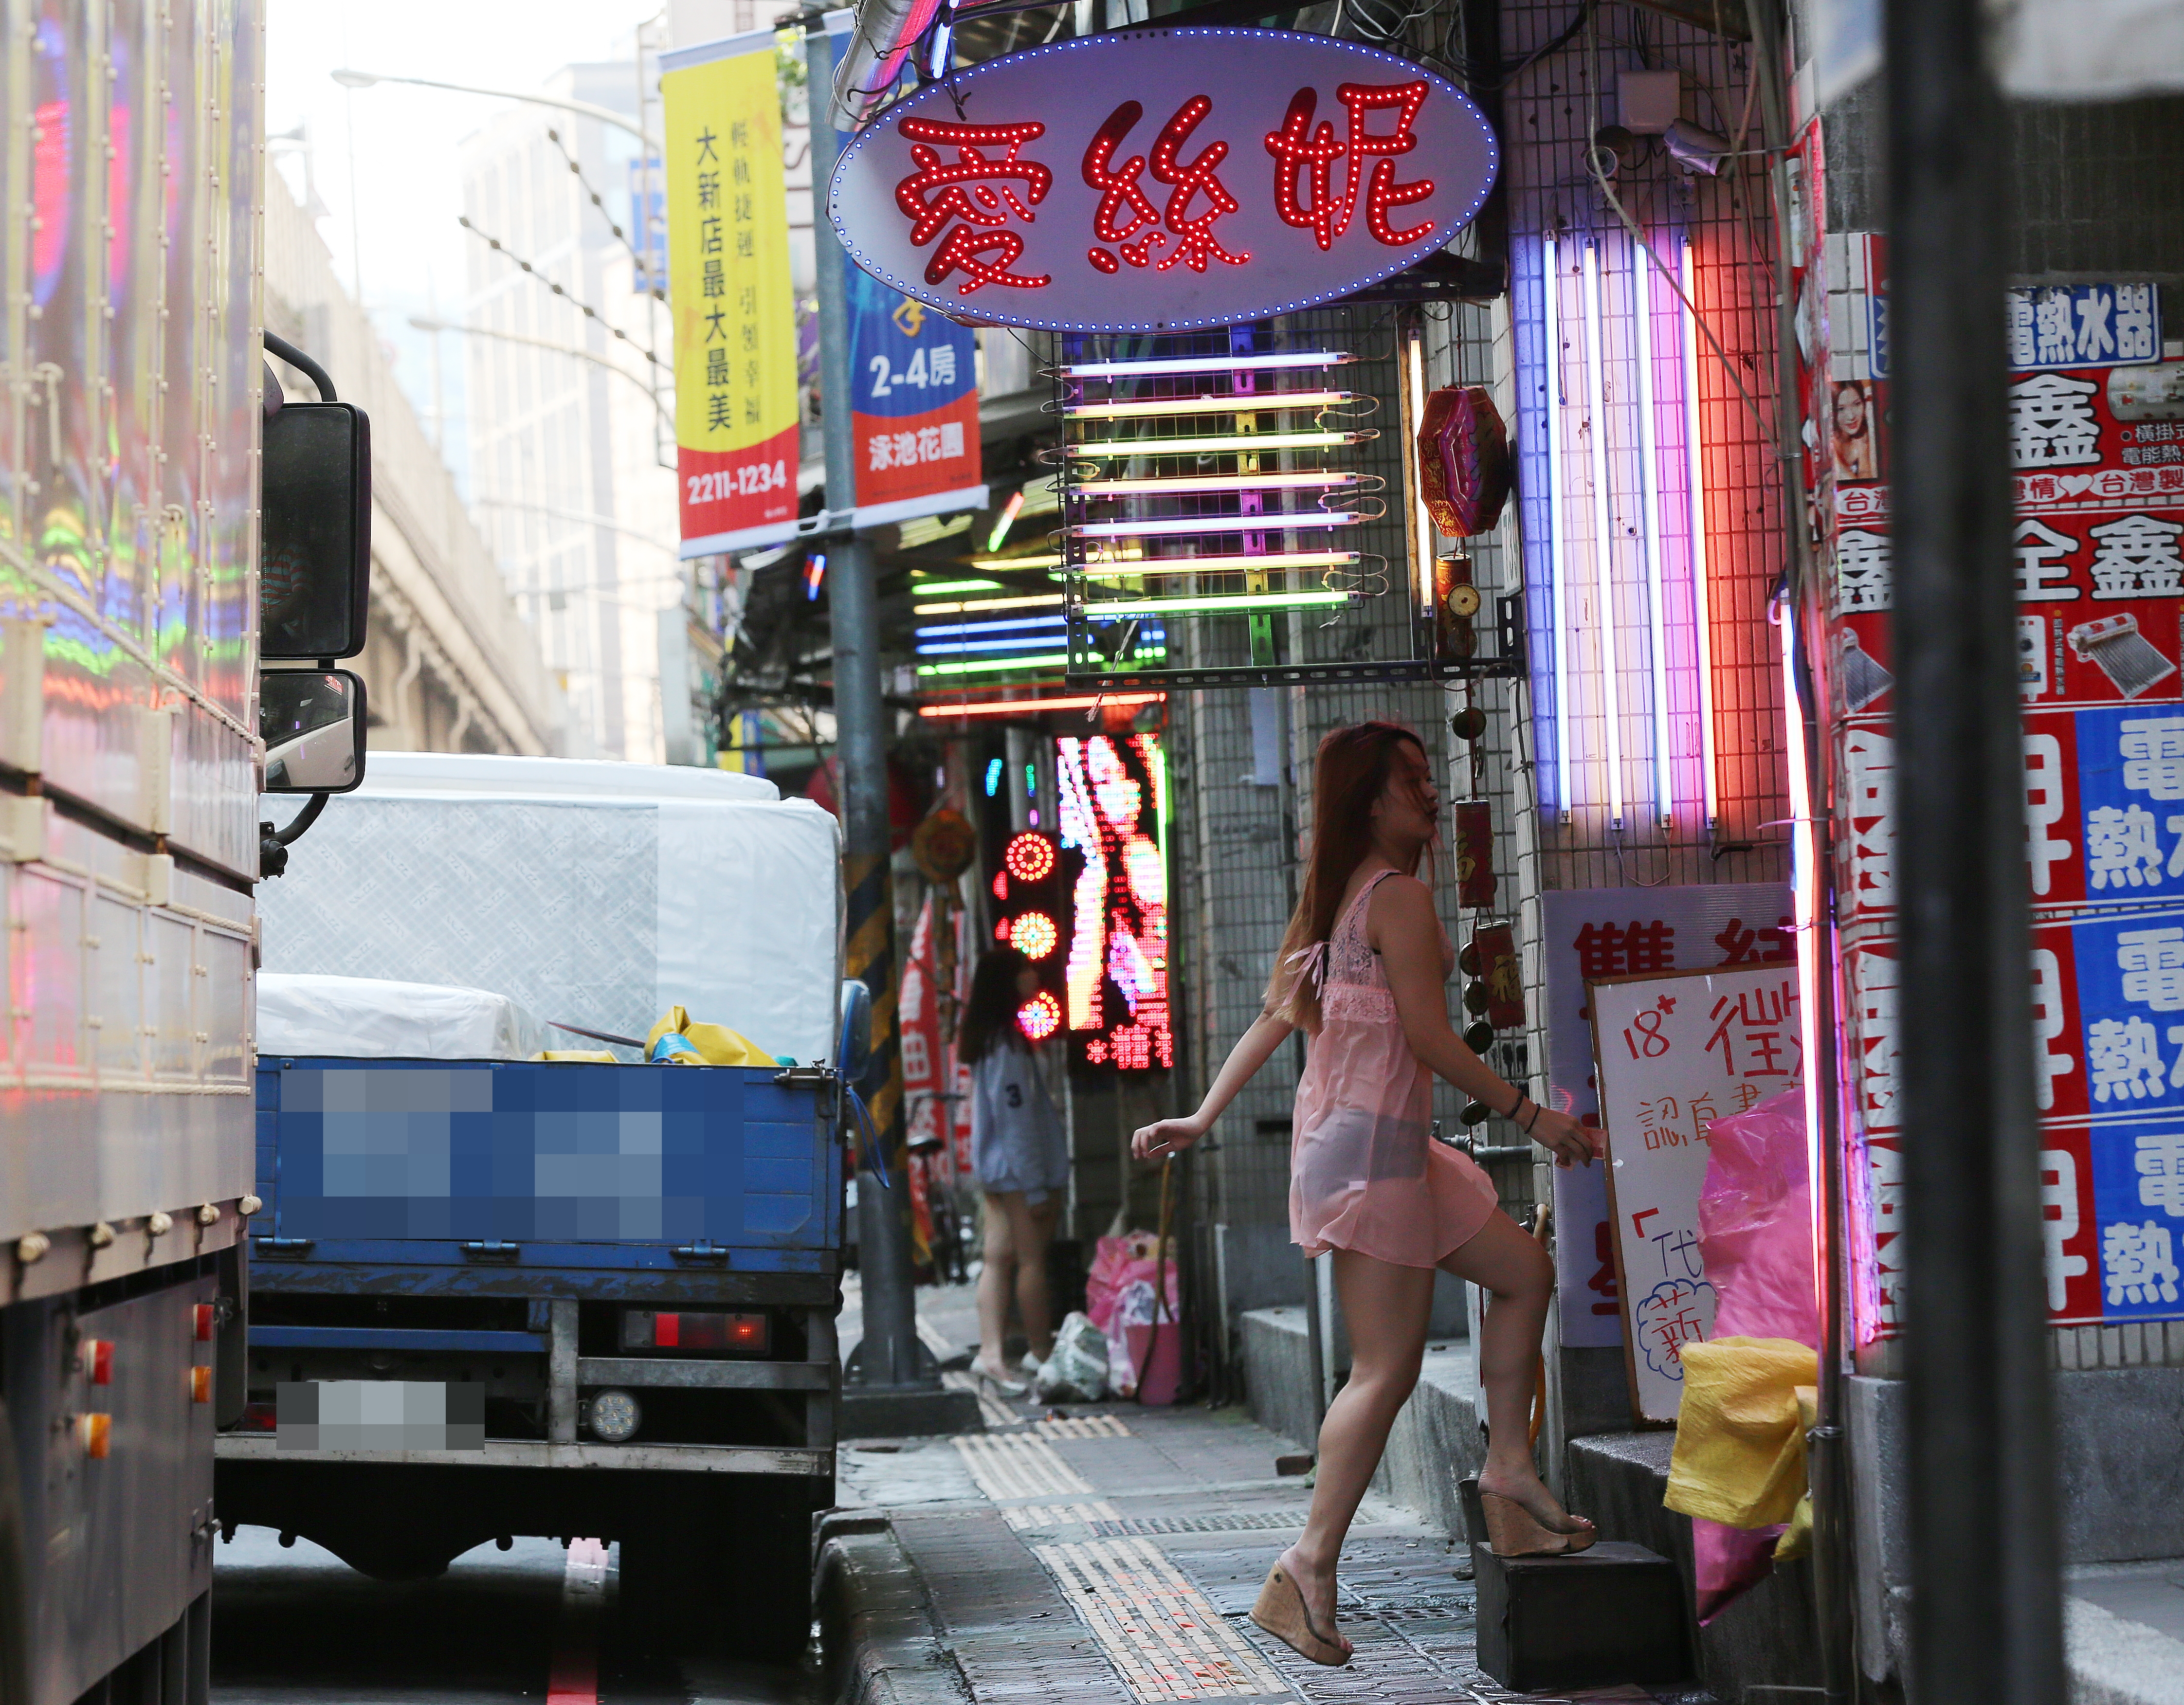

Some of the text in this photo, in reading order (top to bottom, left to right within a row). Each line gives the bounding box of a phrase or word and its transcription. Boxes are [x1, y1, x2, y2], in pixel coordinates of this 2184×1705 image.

[895, 80, 1435, 295] 愛絲妮
[696, 126, 731, 432] 大新店最大最美
[869, 344, 956, 399] 2-4房
[868, 421, 965, 472] 泳池花園
[2009, 374, 2101, 468] 鑫
[2121, 444, 2184, 466] 電能熱
[687, 459, 787, 505] 2211-1234
[2119, 716, 2184, 801] 電
[2087, 803, 2184, 890] 熱
[2117, 927, 2184, 1012] 電
[1005, 1084, 1021, 1108] 3
[2089, 1016, 2184, 1103] 熱
